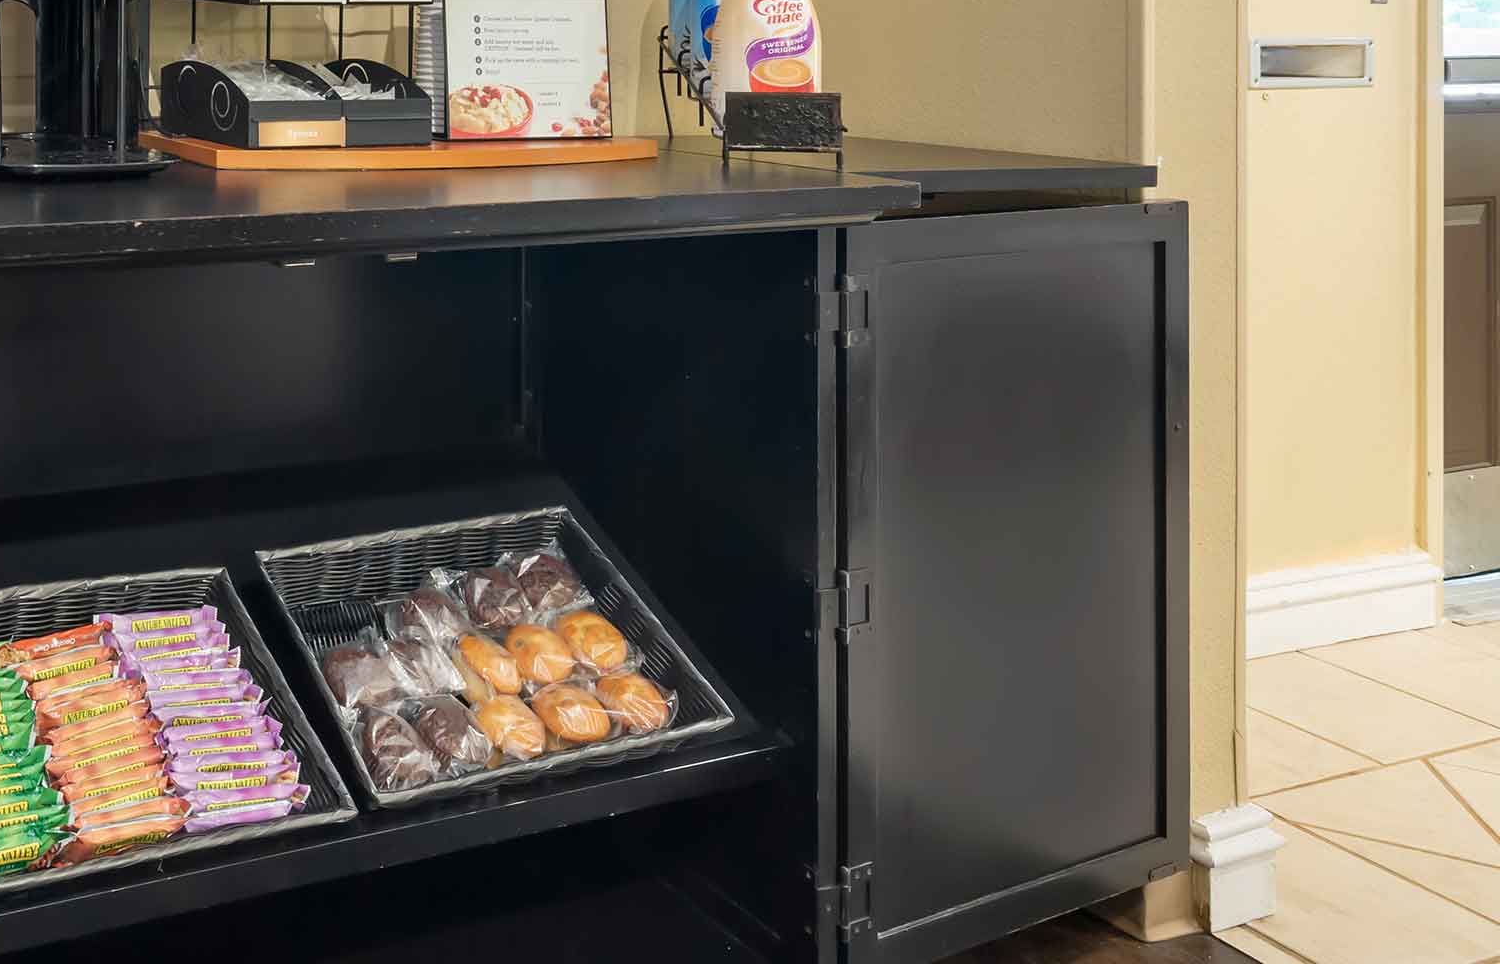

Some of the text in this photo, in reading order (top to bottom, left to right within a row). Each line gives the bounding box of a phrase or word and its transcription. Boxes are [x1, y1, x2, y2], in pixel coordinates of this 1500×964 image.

[767, 13, 803, 25] mate
[134, 616, 190, 632] NATURE VALLEY
[66, 658, 97, 673] VALLEY
[1, 846, 38, 862] VALLEY
